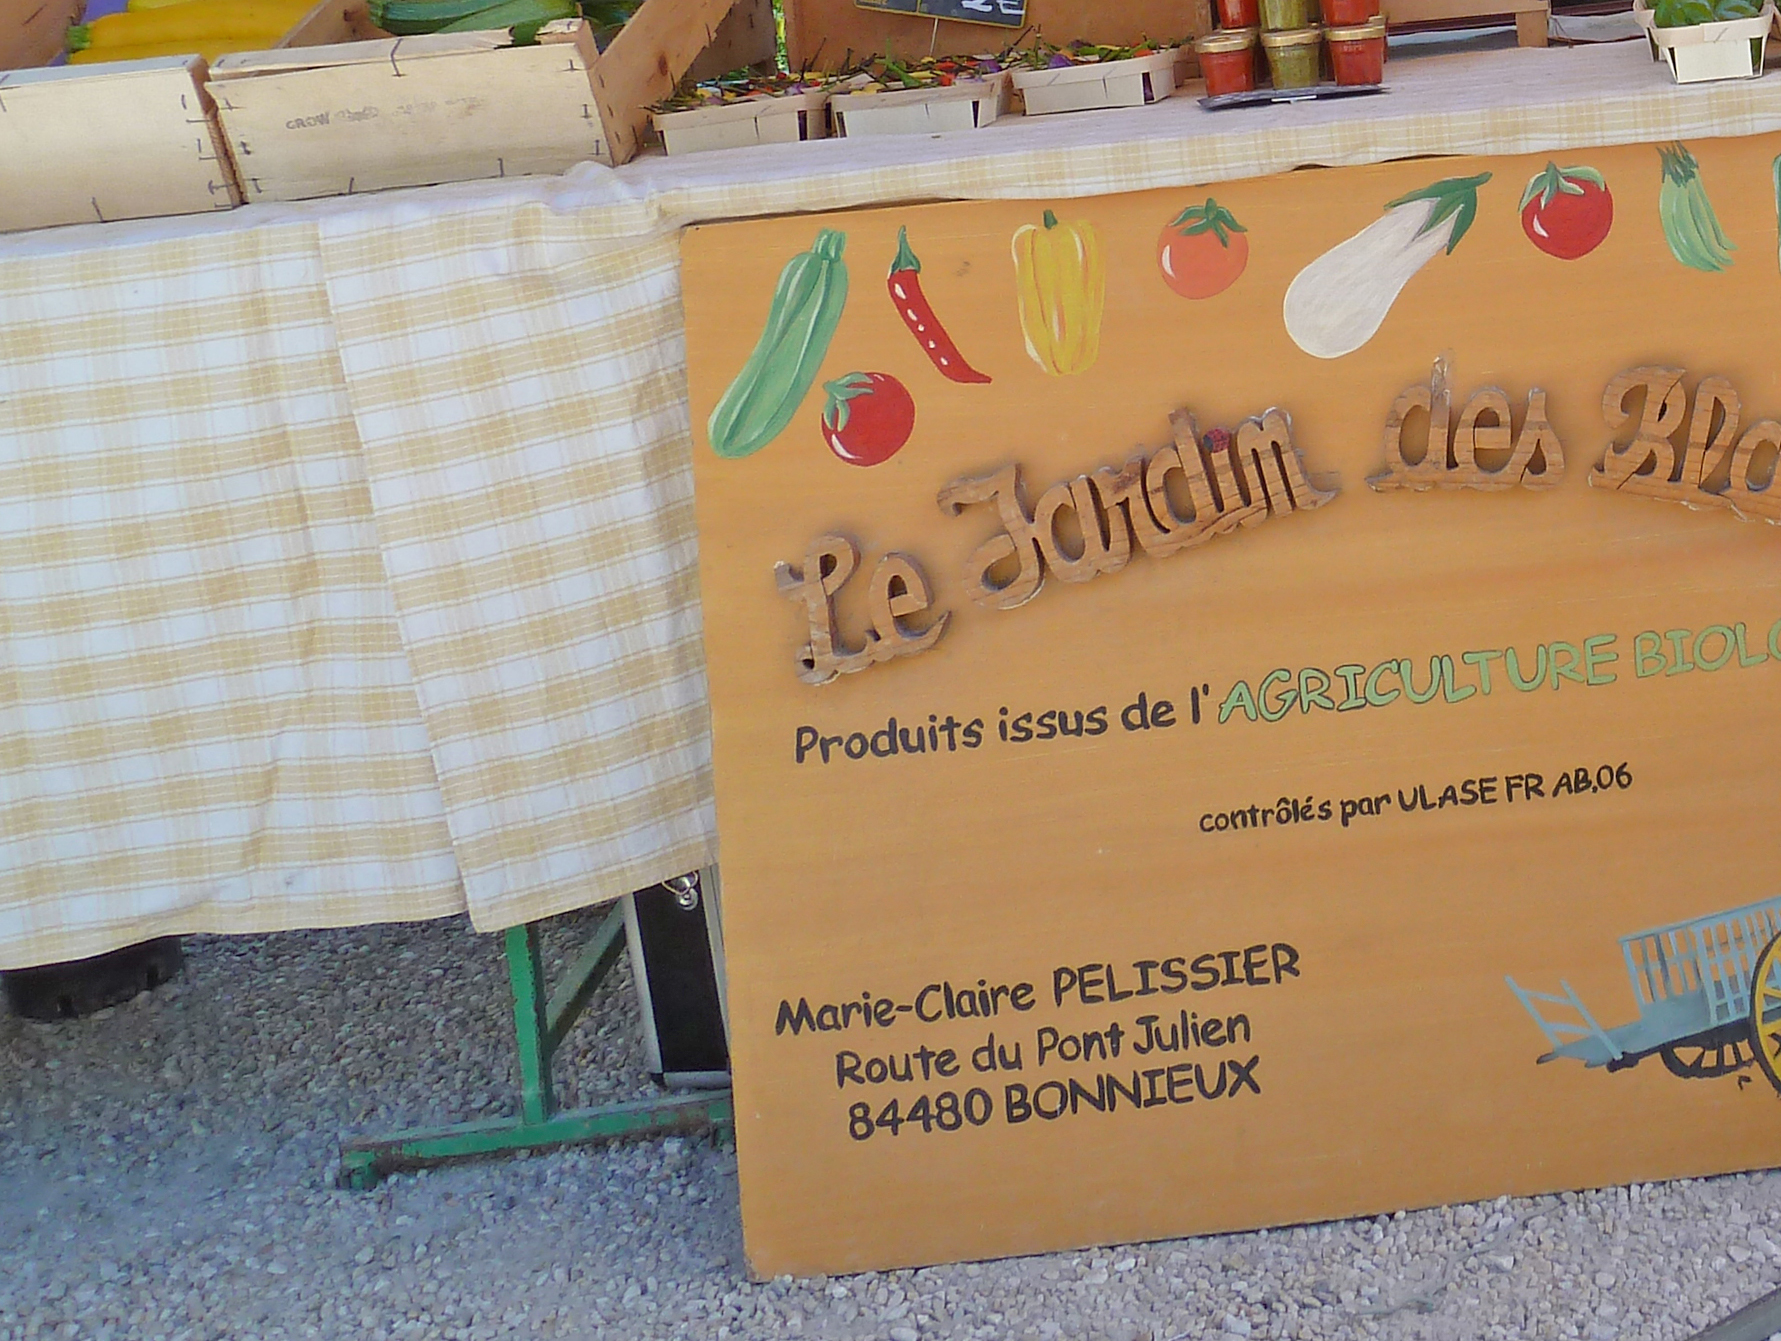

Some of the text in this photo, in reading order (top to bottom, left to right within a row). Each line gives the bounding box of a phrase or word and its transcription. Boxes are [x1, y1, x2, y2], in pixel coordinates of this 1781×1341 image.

[773, 533, 952, 686] Le
[937, 404, 1342, 611] Jardin
[1364, 348, 1567, 493] des
[795, 713, 983, 766] Produits
[998, 703, 1109, 743] issus
[1121, 691, 1177, 733] de
[1198, 794, 1333, 833] contrôlés
[1339, 792, 1391, 828] par
[1398, 775, 1499, 812] ULASE
[1505, 773, 1545, 803] FR
[775, 942, 1301, 1036] Marie-Claire PELISSIER
[835, 1009, 1252, 1089] Route du Pont Julien
[848, 1054, 1262, 1141] 84480 BONNIEUX
